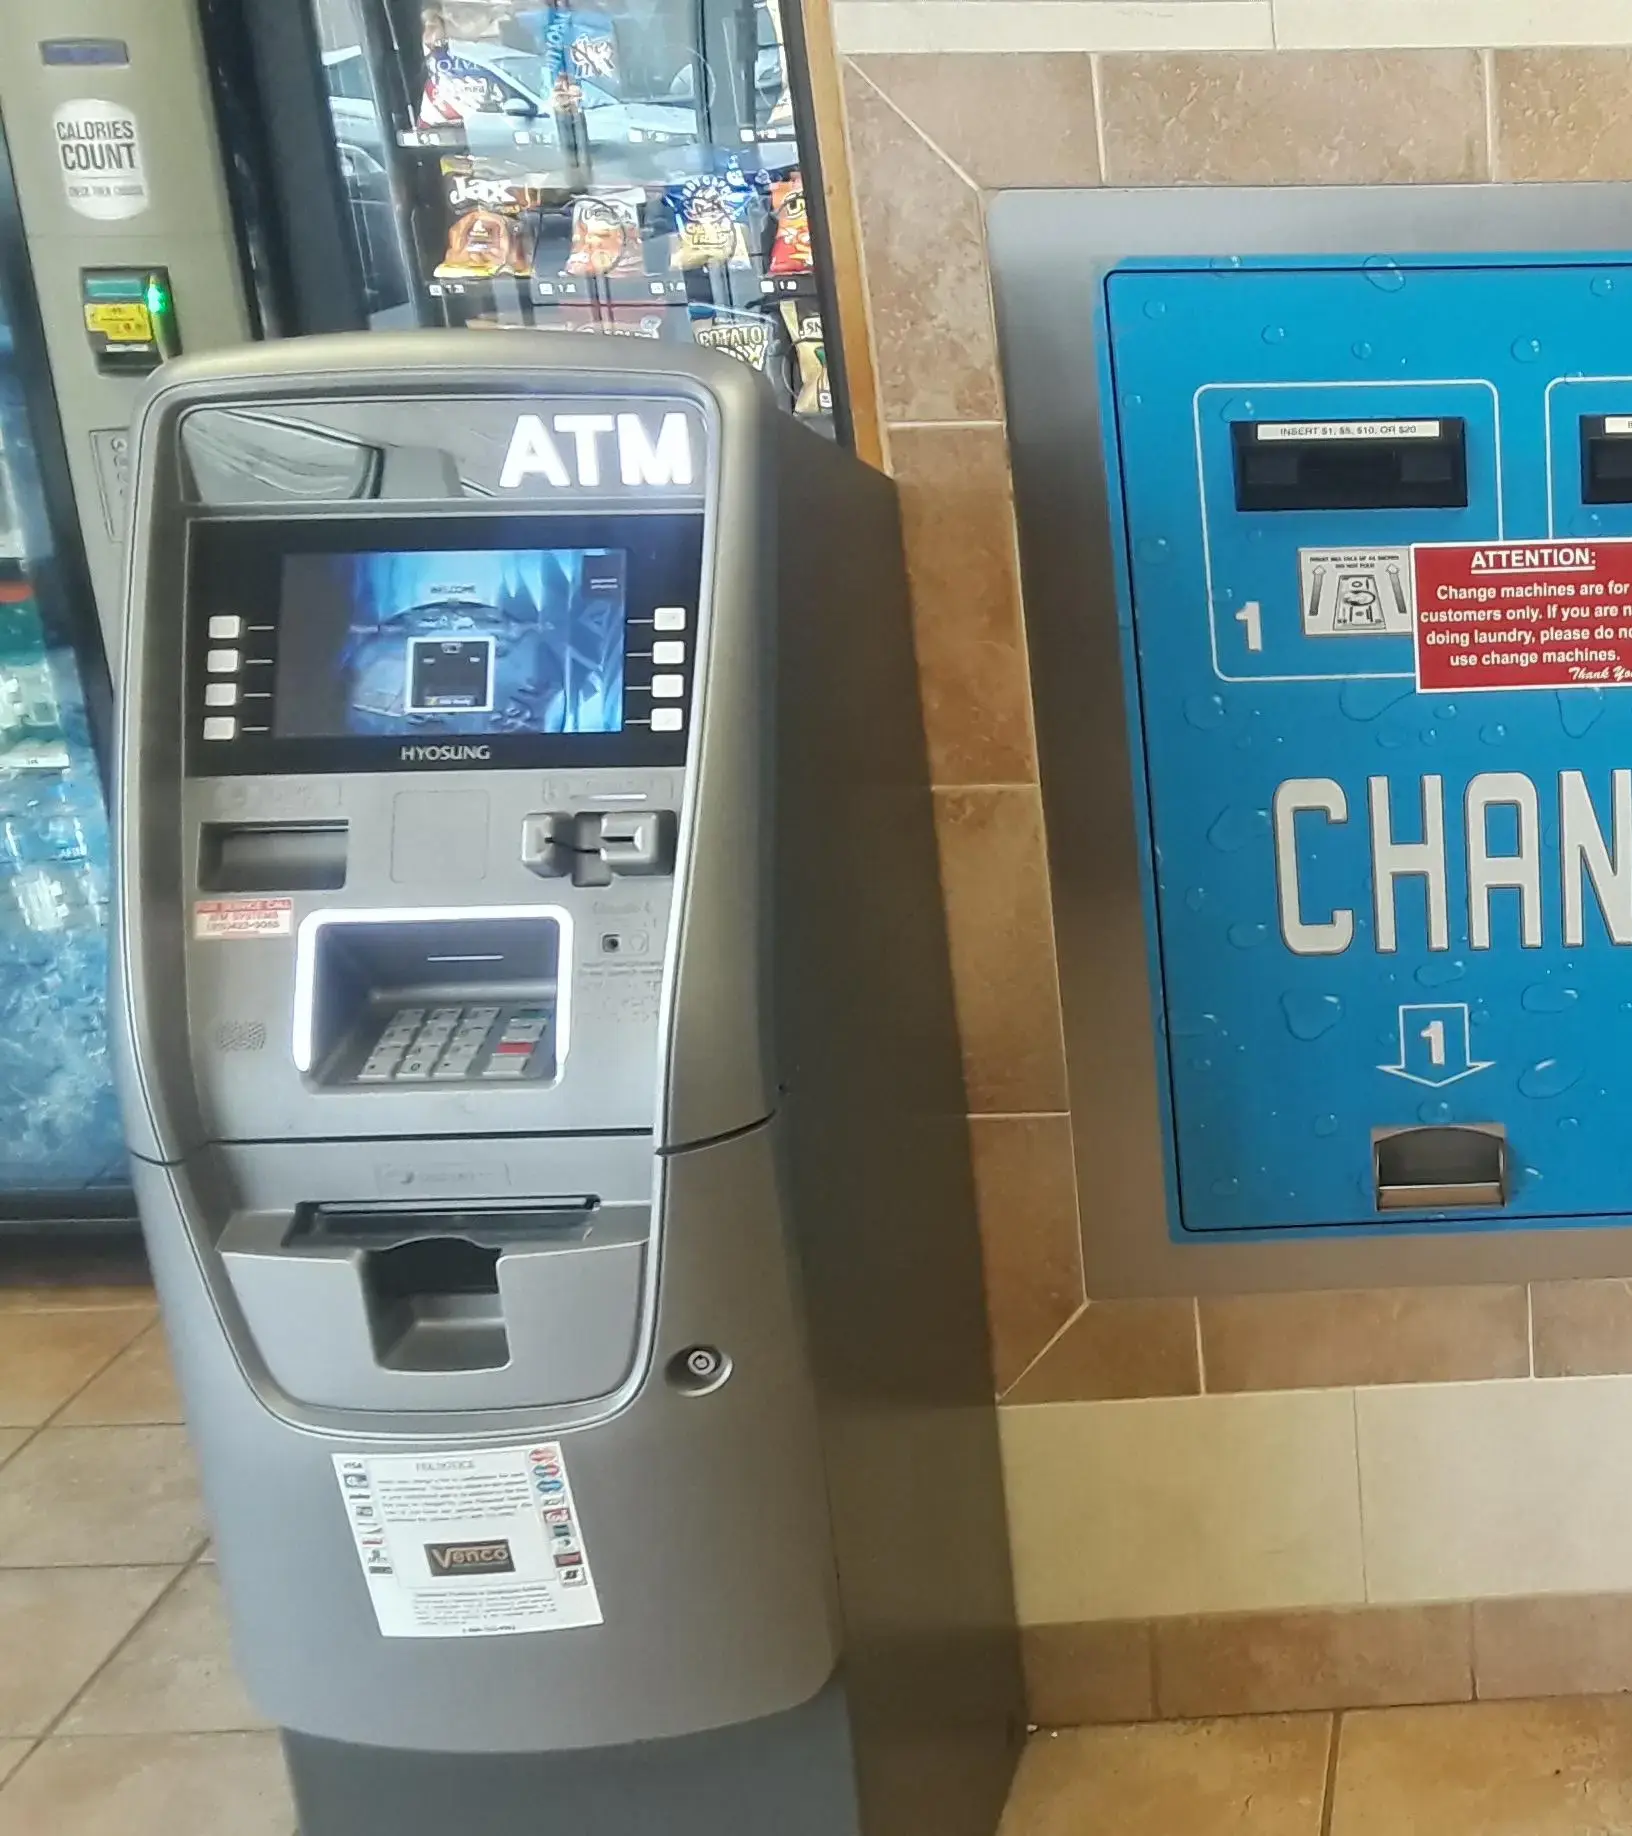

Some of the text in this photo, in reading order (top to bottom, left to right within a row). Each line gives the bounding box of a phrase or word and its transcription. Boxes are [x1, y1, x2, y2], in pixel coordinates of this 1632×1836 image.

[56, 120, 134, 141] CALORIES
[60, 142, 136, 171] COUNT
[450, 176, 518, 204] Jax
[1279, 426, 1318, 436] INSERT
[1379, 425, 1396, 434] OR
[1399, 425, 1416, 434] $20
[499, 411, 693, 488] ATM
[1471, 547, 1596, 569] ATTENTION:
[1437, 580, 1631, 602] Change machines are for
[1420, 608, 1501, 623] customers
[1506, 604, 1543, 623] only.
[1547, 602, 1559, 619] If
[1561, 605, 1590, 622] you
[1594, 603, 1618, 617] are
[1235, 602, 1264, 652] 1
[1426, 631, 1470, 647] doing
[1474, 628, 1536, 645] laundry,
[1540, 626, 1589, 645] please
[1594, 624, 1614, 640] do
[1450, 647, 1621, 668] use change machines.
[1568, 667, 1609, 681] Thank
[401, 745, 491, 761] HYOSUNG
[1420, 1020, 1446, 1065] 1
[431, 1545, 508, 1570] Venco
